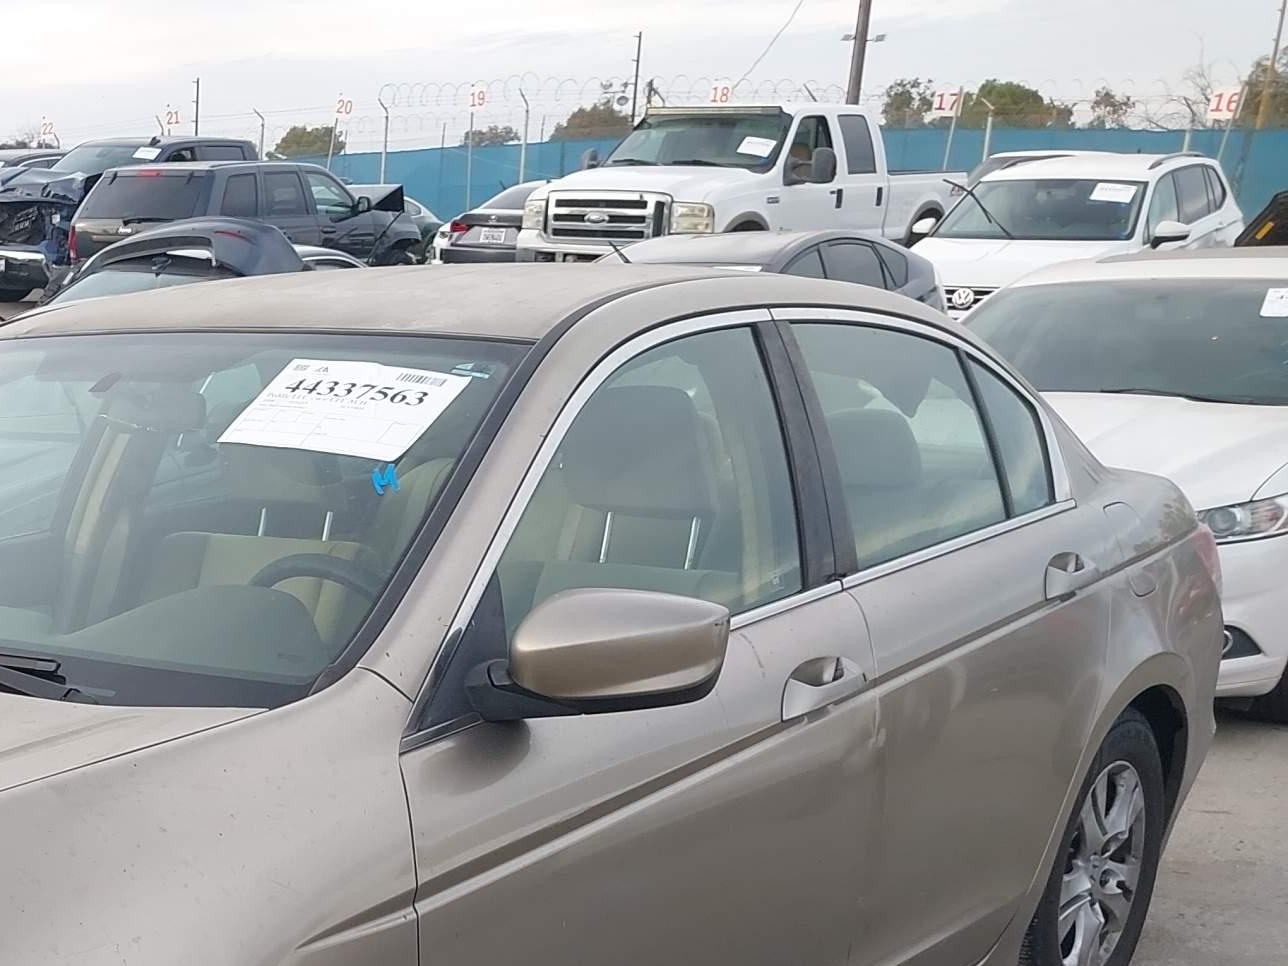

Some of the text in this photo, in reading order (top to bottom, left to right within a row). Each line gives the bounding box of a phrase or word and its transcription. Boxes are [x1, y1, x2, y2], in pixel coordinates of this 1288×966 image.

[470, 90, 486, 107] 19
[710, 86, 730, 103] 18
[934, 92, 960, 111] 17
[1210, 92, 1240, 113] 16
[336, 99, 353, 115] 20
[166, 111, 180, 125] 21
[42, 122, 54, 135] 22
[285, 378, 429, 406] 44337563
